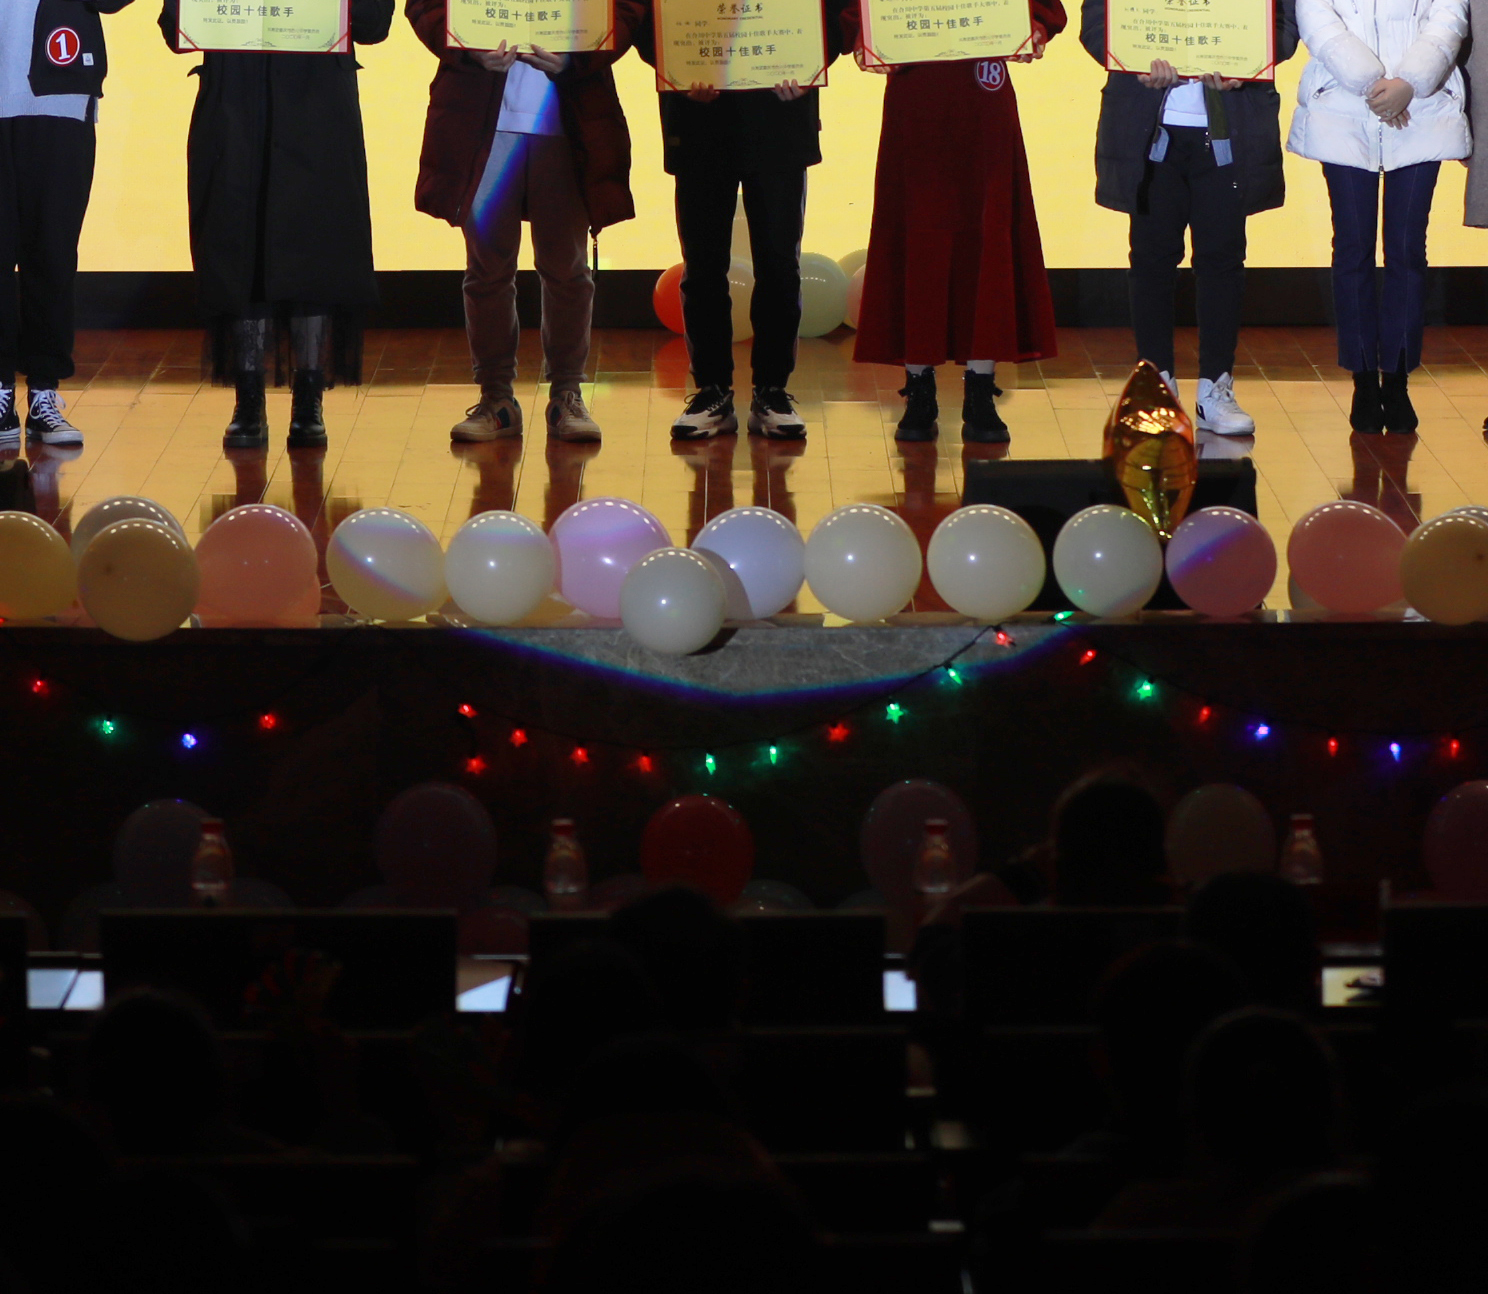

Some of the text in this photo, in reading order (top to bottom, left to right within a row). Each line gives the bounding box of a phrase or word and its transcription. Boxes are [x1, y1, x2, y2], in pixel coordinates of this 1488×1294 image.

[217, 5, 294, 17] 校园十佳歌手
[486, 8, 561, 21] 校园十佳歌手
[717, 3, 763, 14] 荣誉证书
[907, 16, 983, 30] 校园十佳歌手
[1146, 33, 1222, 46] 校园十佳歌手
[55, 33, 71, 60] 1
[699, 44, 776, 57] 校园十佳歌手
[980, 61, 1001, 85] 18
